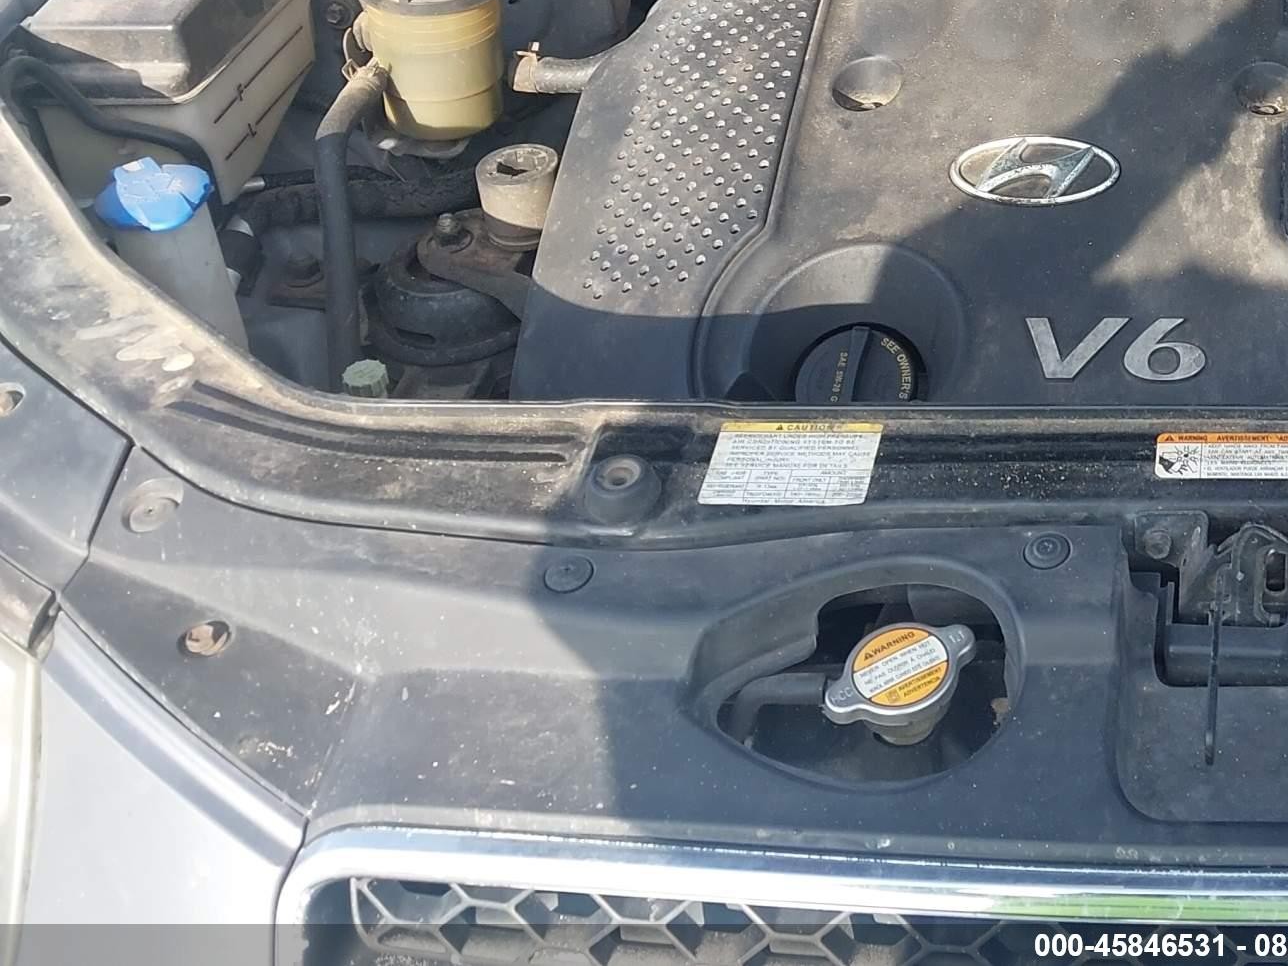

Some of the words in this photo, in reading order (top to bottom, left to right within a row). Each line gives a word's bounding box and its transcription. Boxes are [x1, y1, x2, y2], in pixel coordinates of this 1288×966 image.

[247, 122, 257, 138] L
[839, 351, 849, 367] SAE
[1025, 317, 1207, 381] V6
[881, 337, 902, 355] SEE
[896, 353, 912, 402] OWNER'S
[872, 630, 916, 656] WARNING
[881, 655, 899, 668] OPEN
[903, 675, 941, 698] ADVERTENCIA
